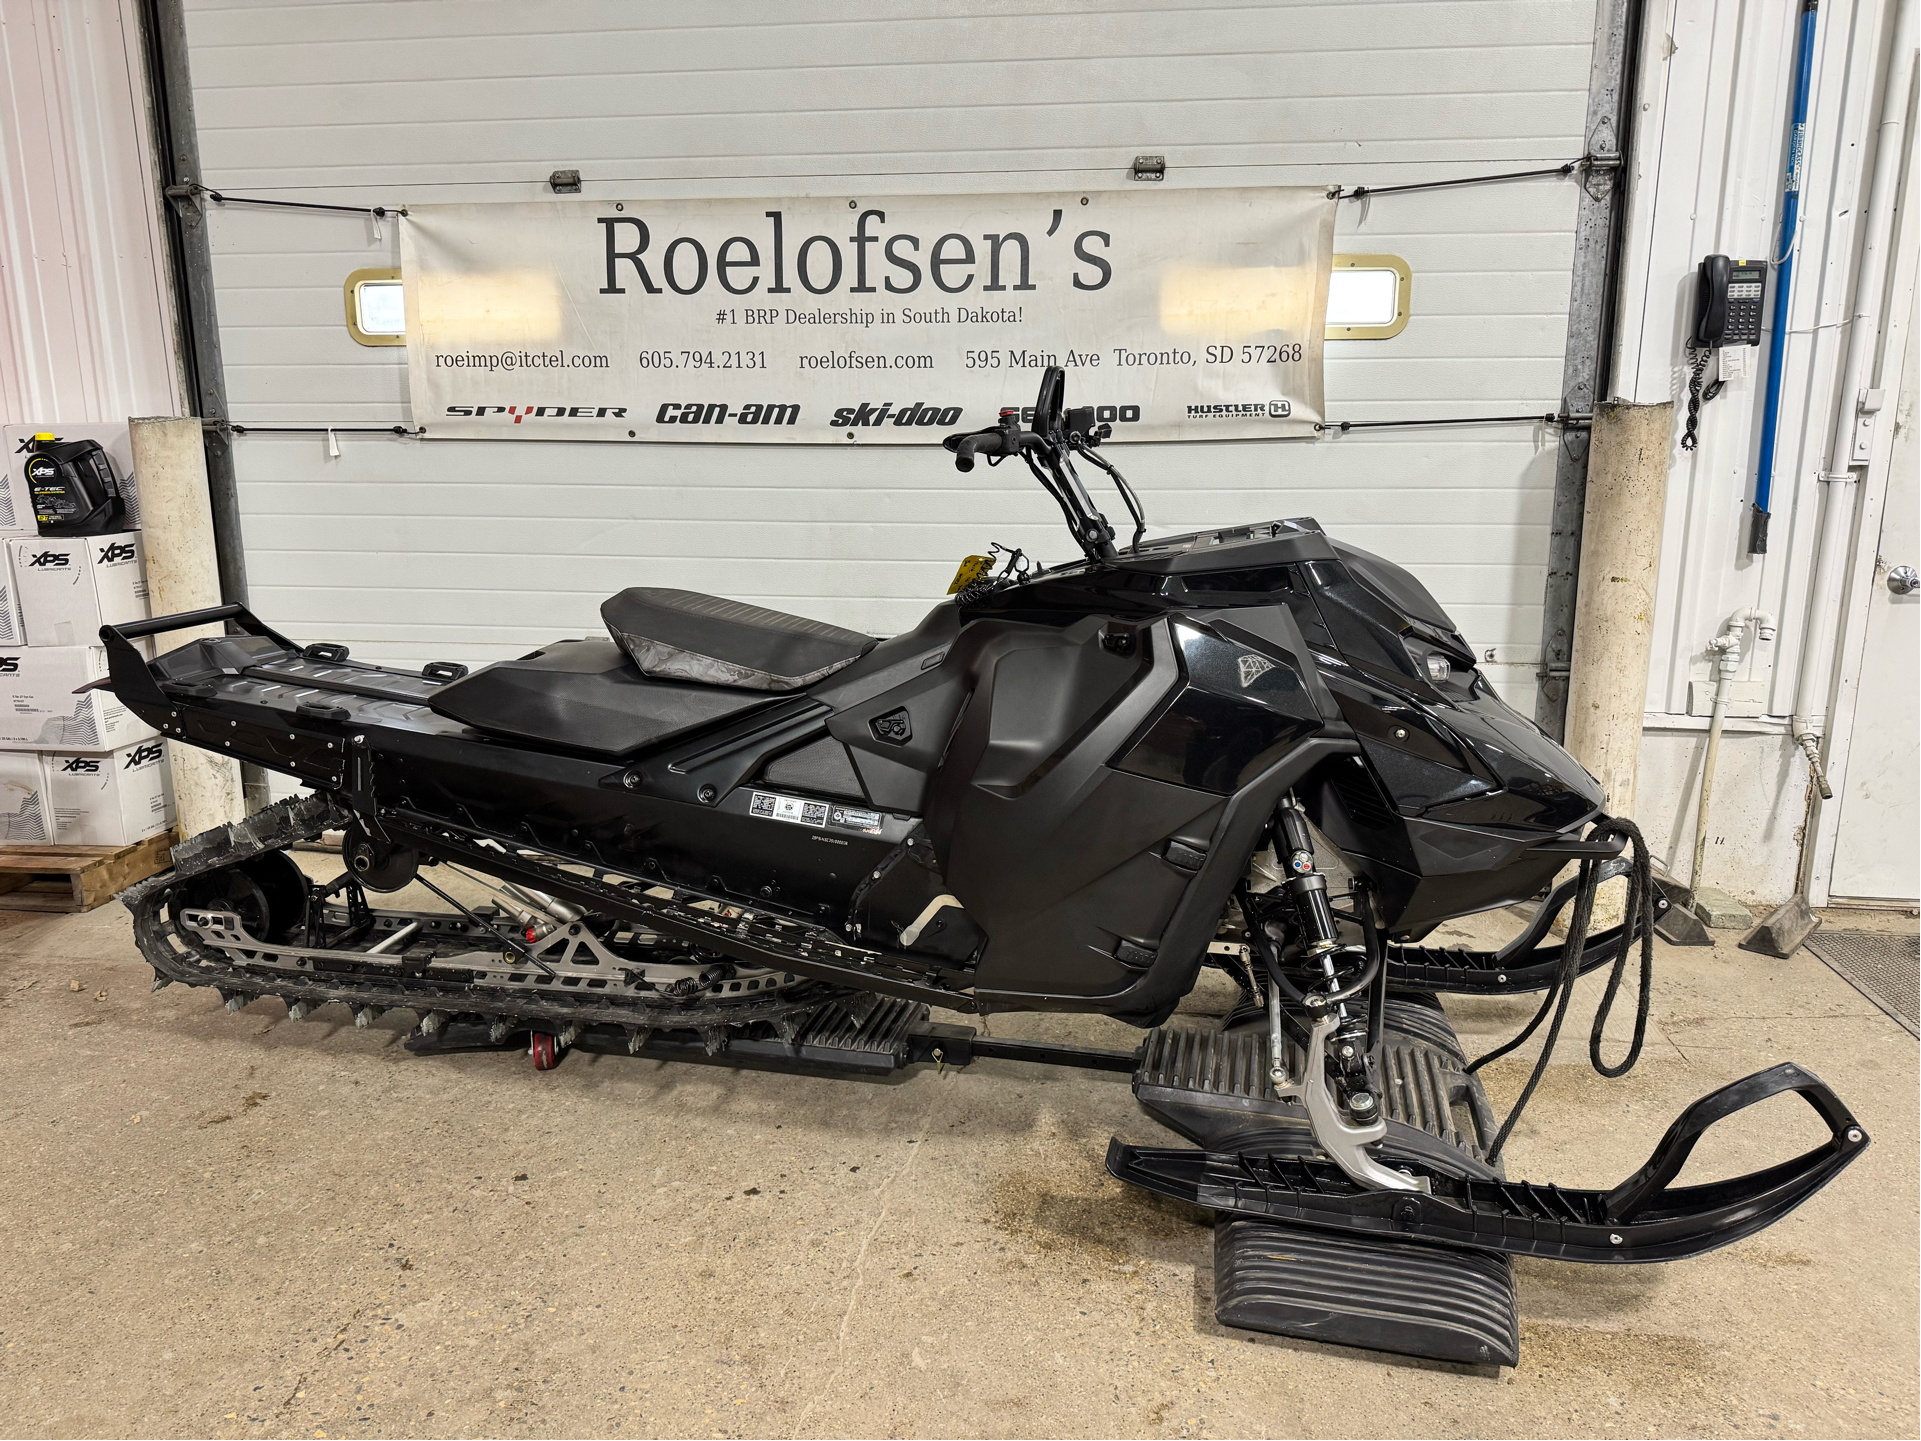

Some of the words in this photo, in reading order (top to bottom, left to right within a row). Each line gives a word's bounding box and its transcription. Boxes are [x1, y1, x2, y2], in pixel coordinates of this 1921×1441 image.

[597, 209, 1113, 295] Roelofsen's
[715, 309, 738, 325] #1
[744, 309, 780, 325] BRP
[785, 307, 875, 328] Dealership
[880, 308, 897, 323] in
[902, 306, 951, 323] South
[957, 306, 1023, 323] Dakota!
[435, 350, 610, 372] roeimp@itctel.com
[639, 351, 768, 369] 605.794.2131
[799, 351, 935, 369] roelofsen.com
[965, 350, 1001, 368] 595
[1008, 349, 1057, 368] Main
[1064, 348, 1100, 368] Ave
[1112, 347, 1197, 367] Toronto,
[1205, 345, 1234, 364] SD
[1241, 343, 1303, 363] 57268
[655, 402, 801, 426] can-am
[829, 402, 964, 427] ski-doo
[1187, 403, 1266, 415] HUSTLER
[31, 466, 56, 477] XPS
[28, 551, 71, 567] XPS
[97, 542, 137, 565] XPS
[61, 757, 101, 772] XPS
[123, 742, 164, 770] XPS
